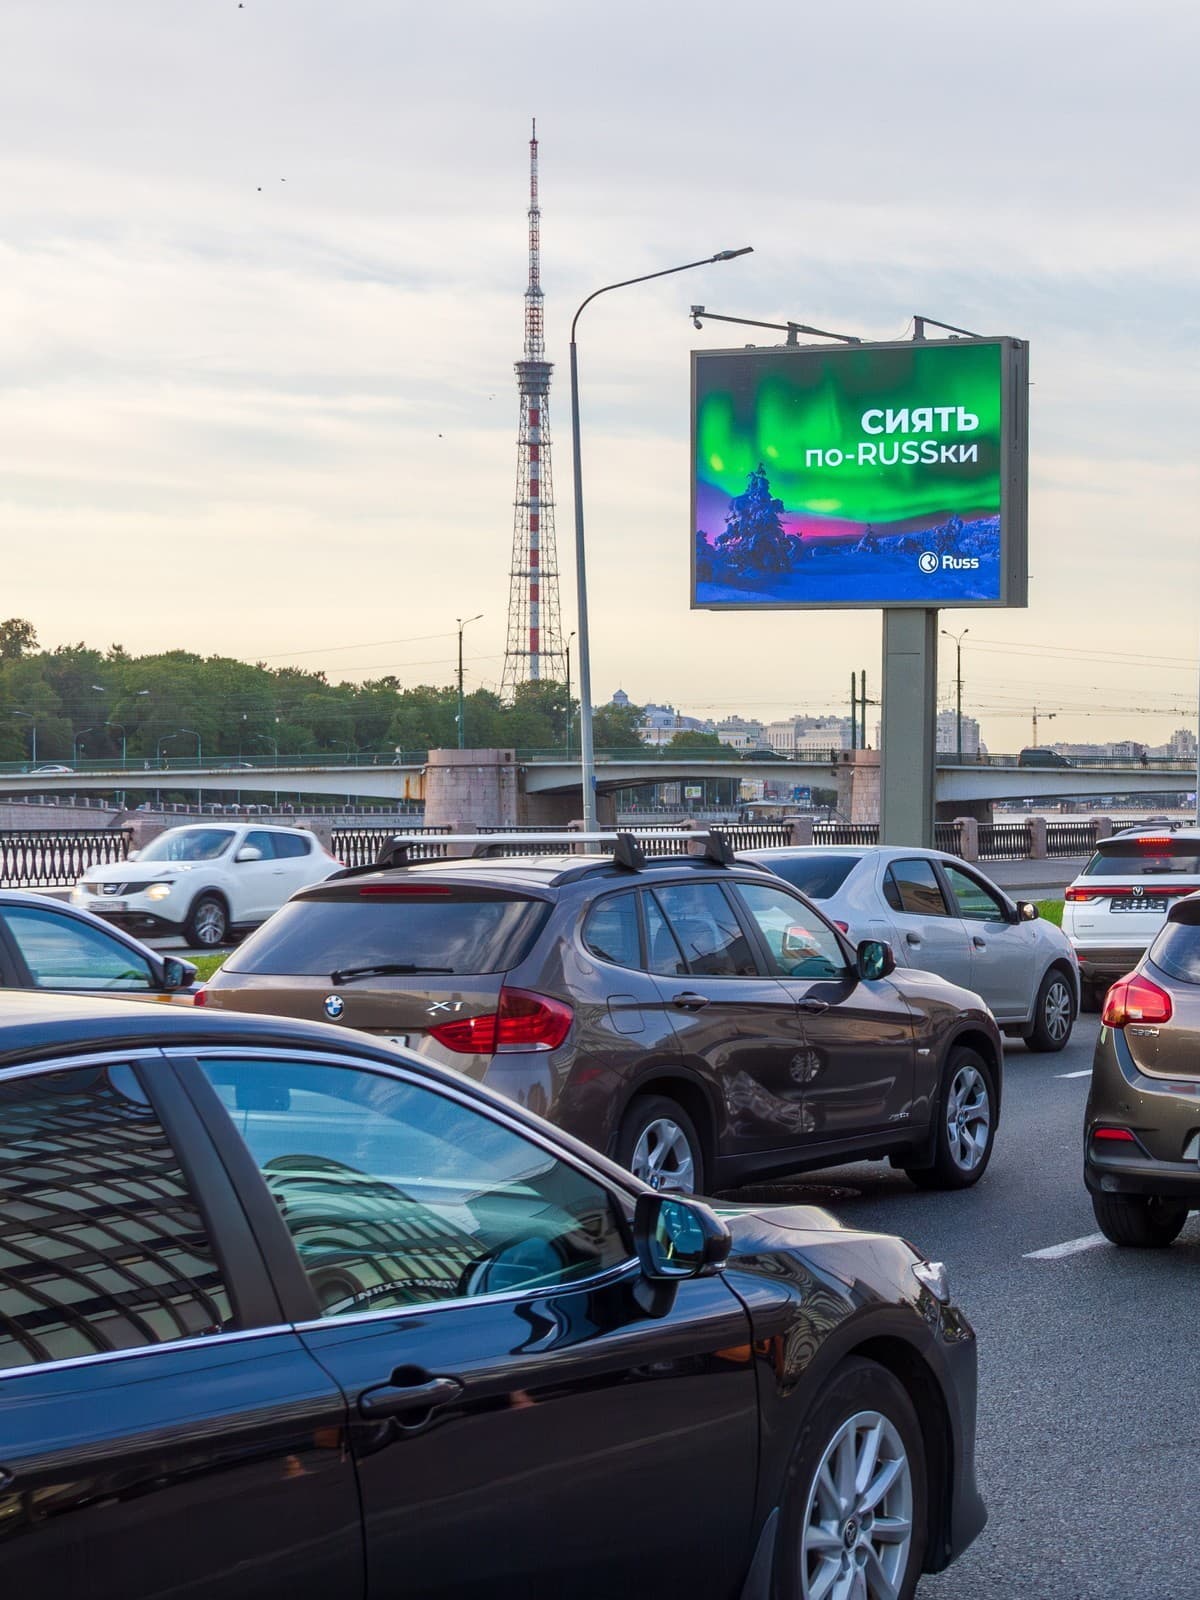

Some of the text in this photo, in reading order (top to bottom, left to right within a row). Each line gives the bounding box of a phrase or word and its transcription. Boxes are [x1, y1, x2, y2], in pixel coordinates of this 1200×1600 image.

[805, 441, 978, 467] по-RUSSки
[942, 555, 979, 570] Russ
[425, 1001, 464, 1012] X1
